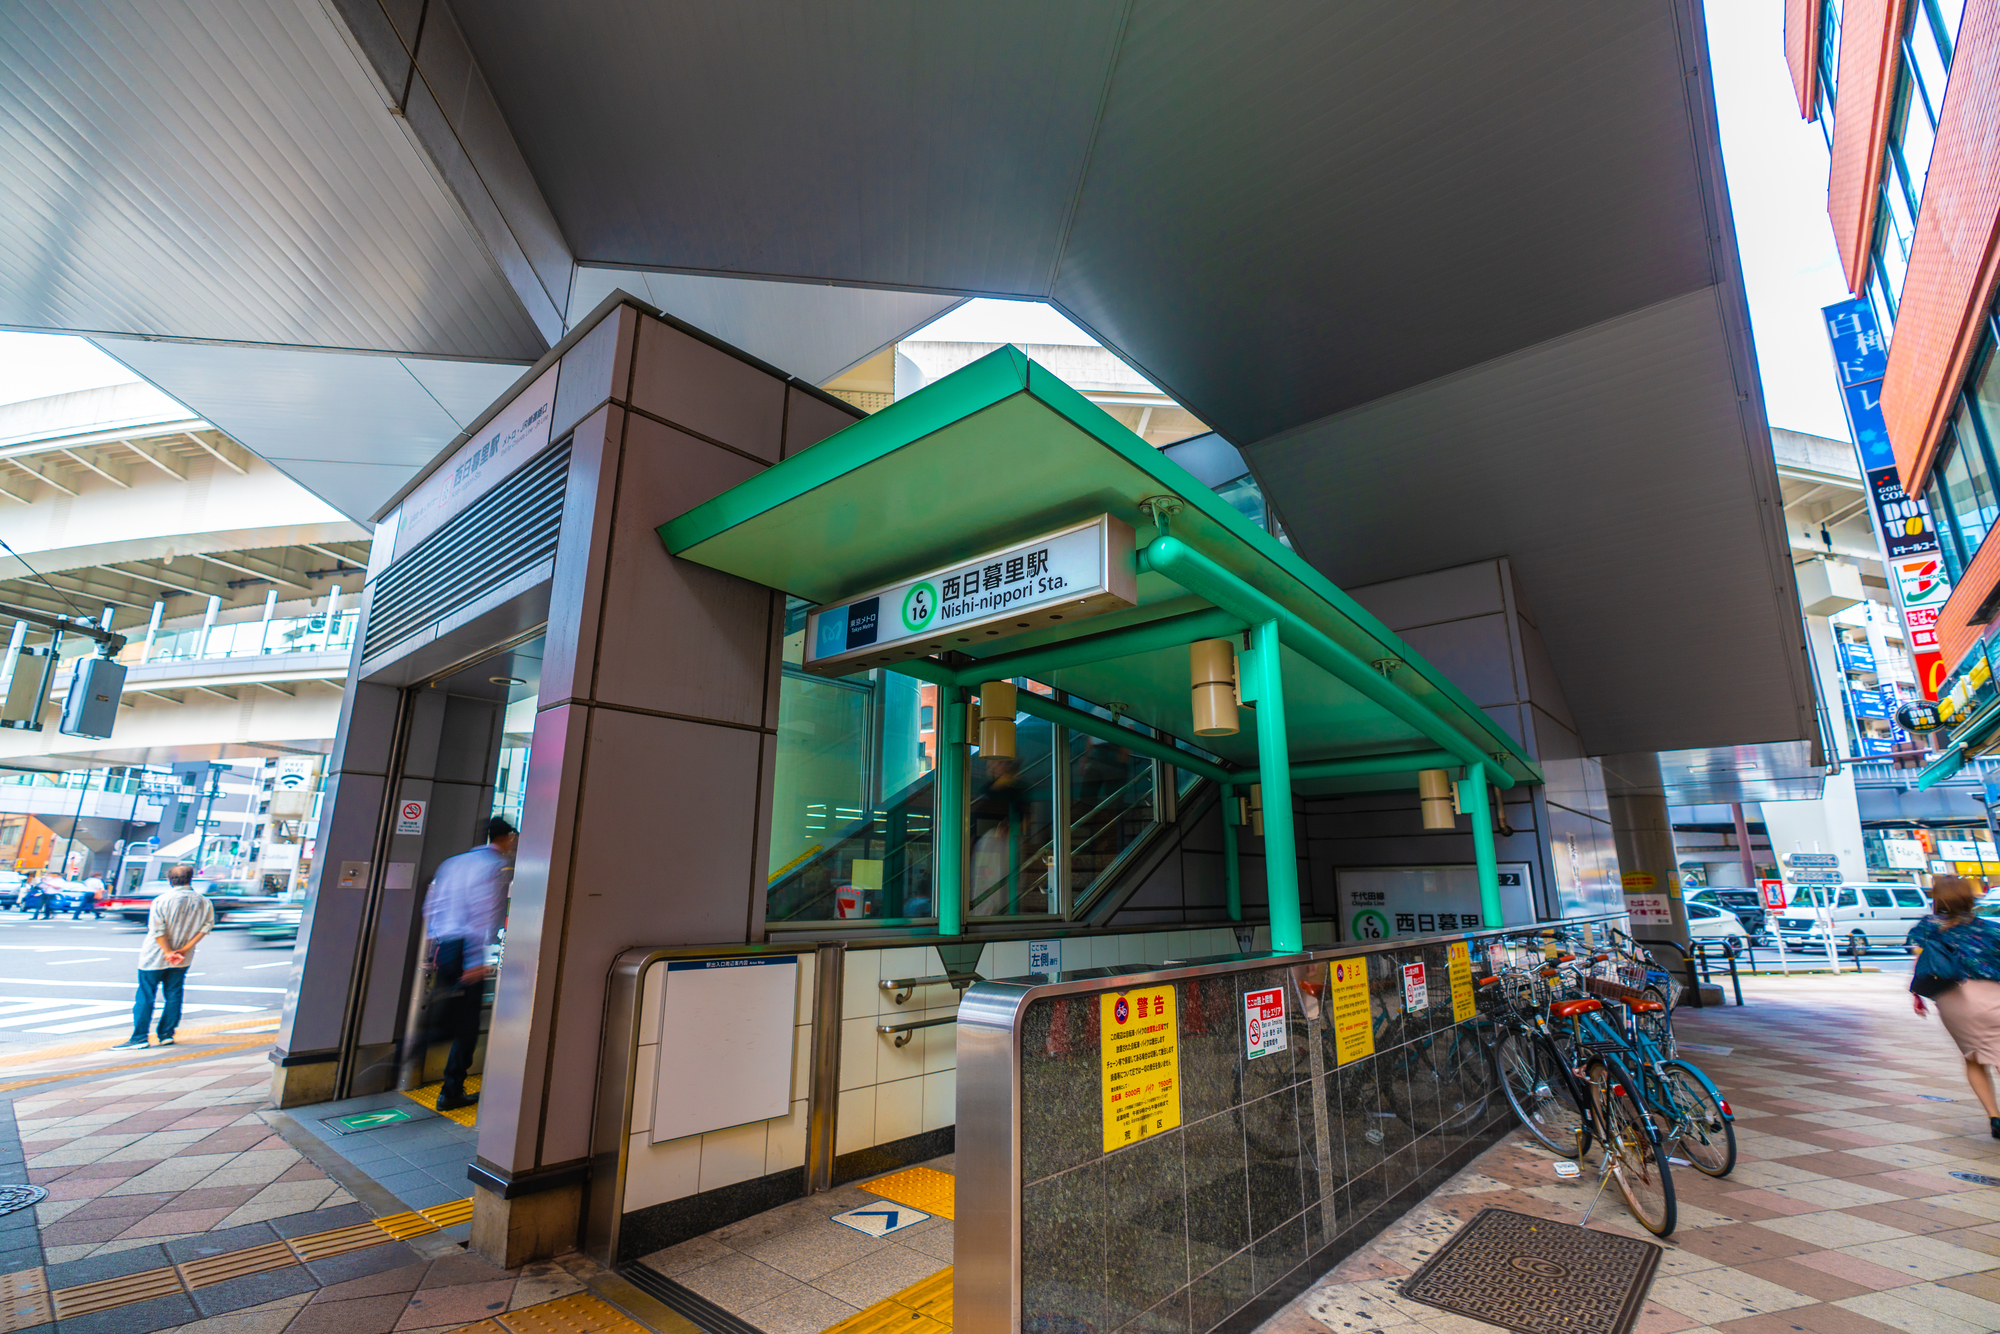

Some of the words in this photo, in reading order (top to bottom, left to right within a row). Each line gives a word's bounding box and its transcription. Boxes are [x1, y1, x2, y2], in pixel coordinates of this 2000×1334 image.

[453, 433, 501, 486] 西日暮里駅
[942, 548, 1049, 604] 西日暮里駅
[916, 591, 924, 604] C
[941, 580, 1033, 620] Nishi-nippori
[1038, 575, 1068, 593] Sta.
[912, 604, 928, 621] 16
[850, 613, 876, 628] 東京メトロ
[862, 623, 874, 631] Metro
[1506, 874, 1515, 885] 2
[1351, 891, 1385, 901] 千代田線
[1366, 916, 1374, 927] C
[1363, 927, 1380, 938] 16
[1137, 994, 1165, 1019] 警告
[1262, 1006, 1282, 1019] 禁止エリア
[1111, 1093, 1122, 1103] 自転車
